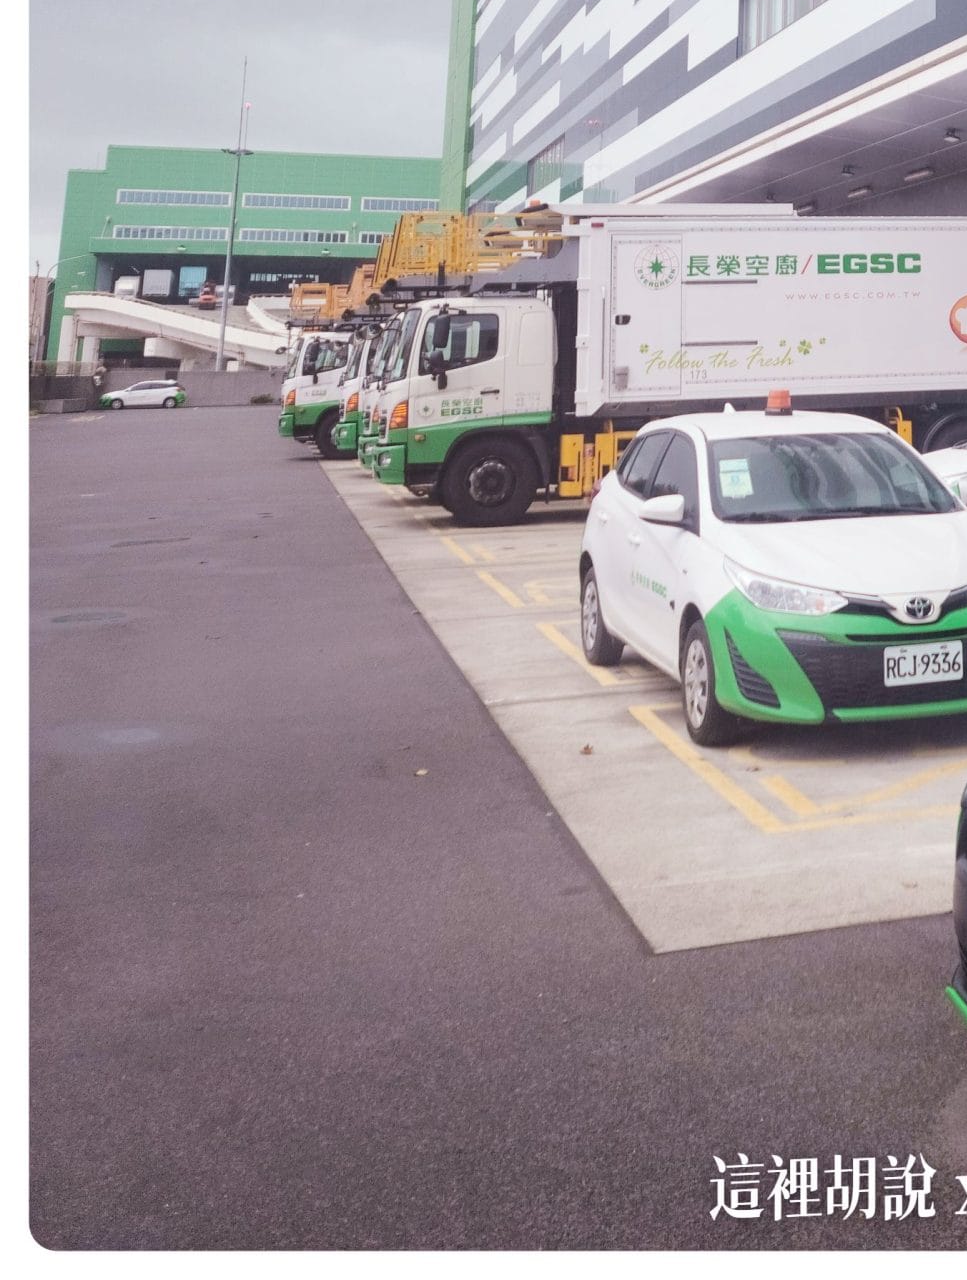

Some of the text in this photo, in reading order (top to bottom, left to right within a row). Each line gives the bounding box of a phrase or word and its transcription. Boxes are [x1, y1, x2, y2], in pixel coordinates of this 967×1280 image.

[644, 349, 704, 374] Follow
[746, 345, 794, 370] Fresh
[440, 406, 483, 417] EGSC
